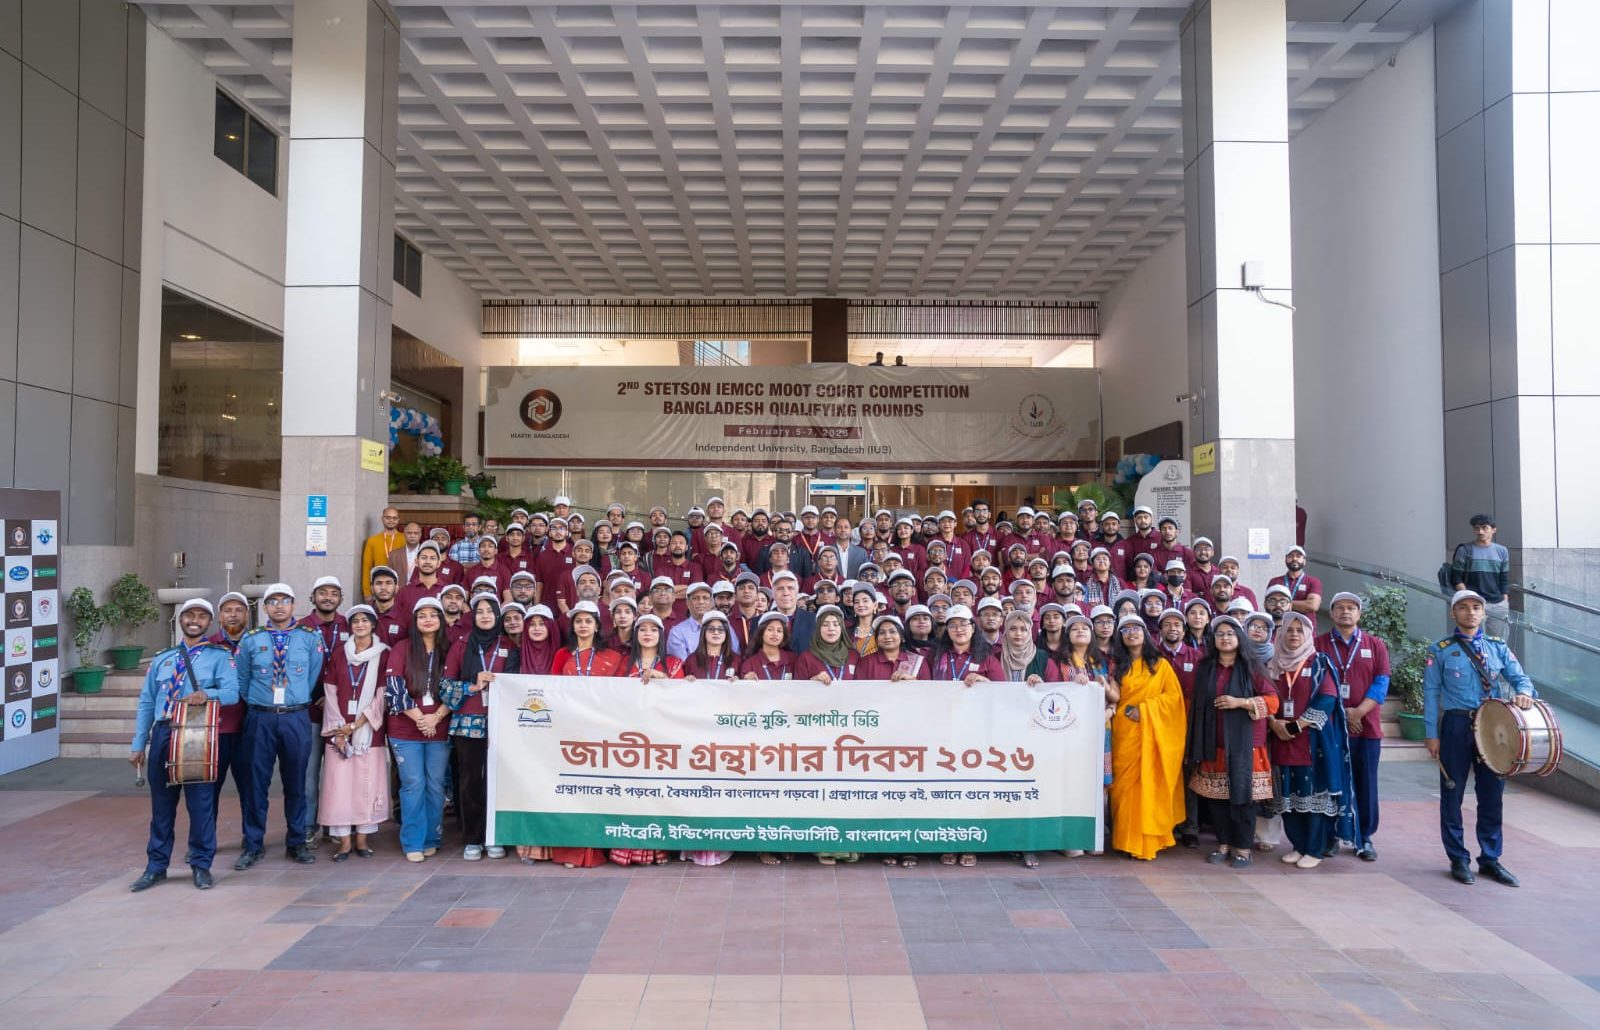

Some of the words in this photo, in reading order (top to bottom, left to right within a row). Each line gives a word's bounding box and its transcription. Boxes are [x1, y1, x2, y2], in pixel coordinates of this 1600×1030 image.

[644, 382, 711, 396] STETSON
[716, 382, 764, 397] IEMCC
[769, 383, 812, 398] MOOT
[816, 384, 864, 399] COURT
[869, 385, 970, 399] COMPETITION
[663, 401, 764, 415] BANGLADESH
[769, 402, 857, 418] QUALIFYING
[862, 403, 924, 417] ROUNDS
[738, 426, 790, 436] February
[695, 442, 755, 454] Independent
[758, 443, 808, 455] University,
[811, 444, 864, 456] Bangladesh
[867, 445, 892, 455] (IUB)
[714, 712, 758, 728] জ্ঞানেই
[760, 710, 791, 730] মুক্তি,
[795, 710, 849, 728] আগামীর
[852, 710, 880, 728] ভিত্তি
[559, 732, 682, 771] জাতীয়
[689, 742, 828, 776] গ্রন্থাগার
[833, 734, 929, 773] দিবস
[936, 745, 1035, 773] ২০২৬
[555, 784, 603, 796] গ্রন্থাগারে
[605, 784, 622, 797] বই
[667, 785, 721, 799] বৈষম্যহীন
[724, 789, 780, 799] বাংলাদেশ
[828, 789, 878, 801] গ্রন্থাগারে
[909, 788, 928, 801] বই,
[930, 790, 962, 800] জ্ঞানে
[965, 791, 990, 801] গুনে
[993, 790, 1022, 803] সমৃদ্ধ
[1024, 788, 1040, 800] হই
[604, 822, 666, 840] লাইব্রেরি,
[846, 829, 911, 842] বাংলাদেশ
[914, 826, 988, 843] (আইইউবি)
